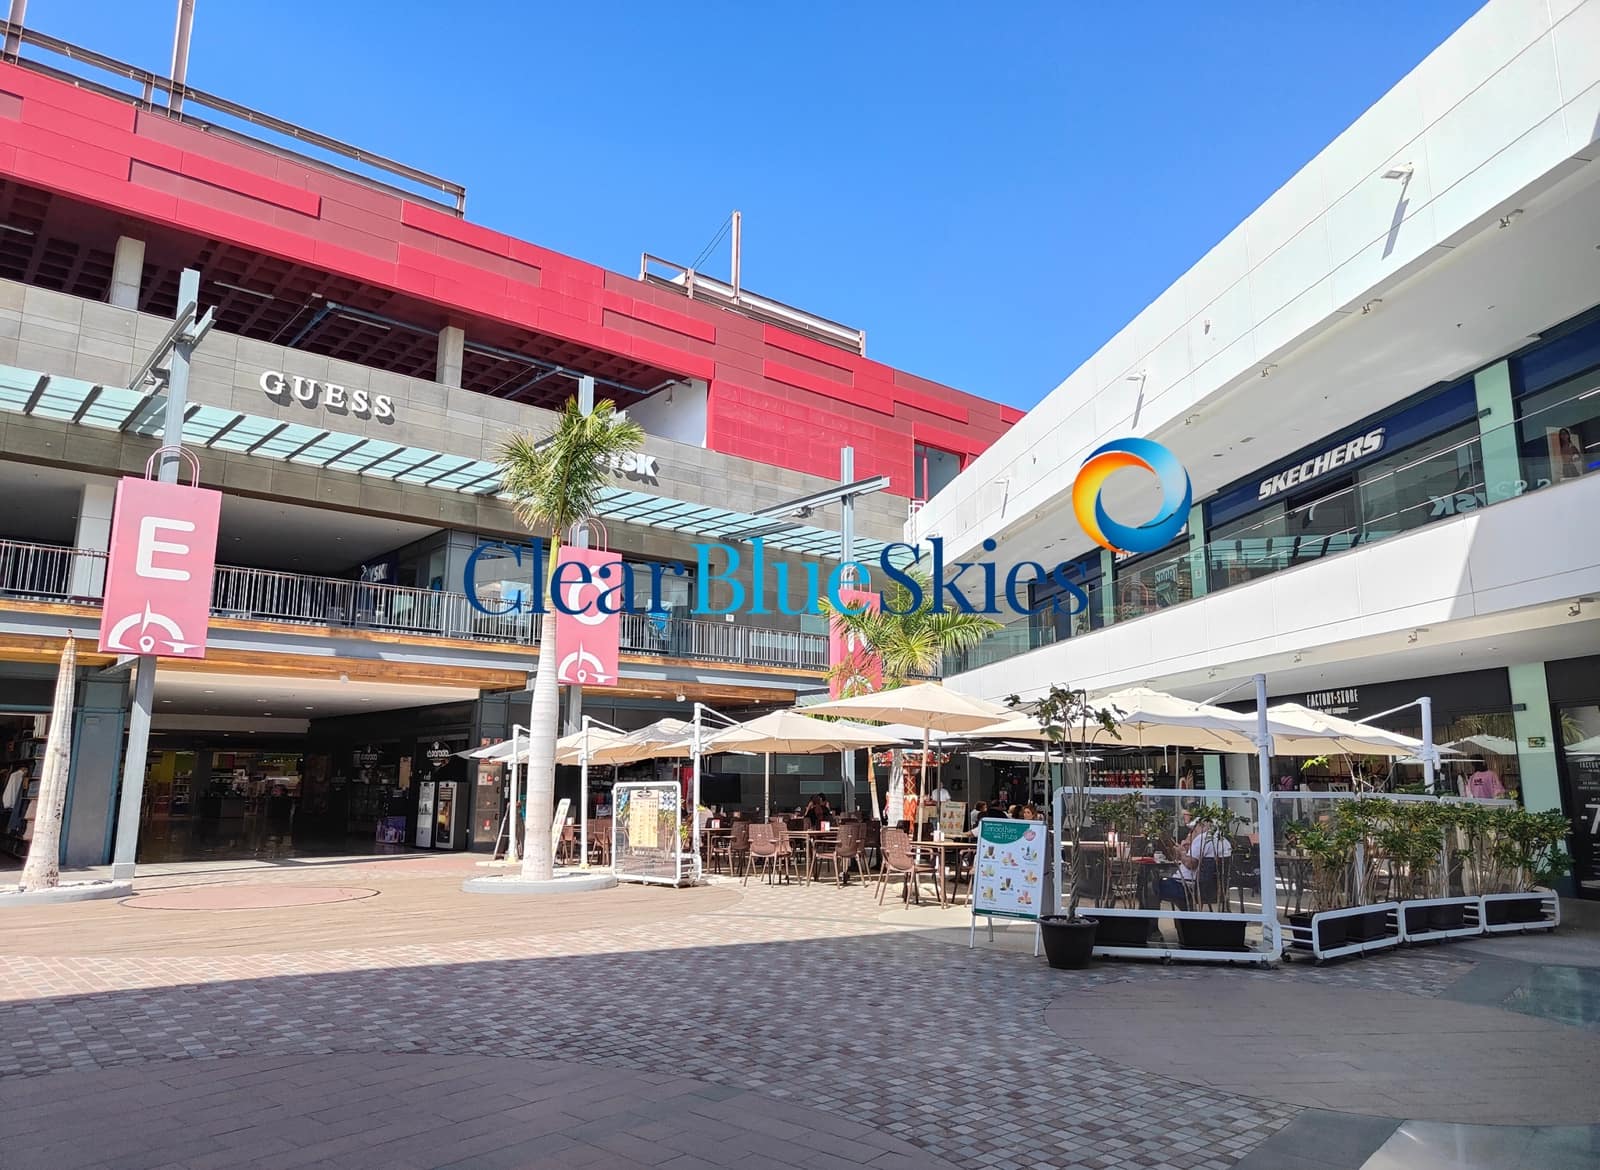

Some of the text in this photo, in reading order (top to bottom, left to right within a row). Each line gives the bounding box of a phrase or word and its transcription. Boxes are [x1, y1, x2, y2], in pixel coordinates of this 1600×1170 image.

[260, 370, 394, 418] GUESS
[1258, 427, 1386, 501] SKECHERS
[135, 515, 196, 582] E
